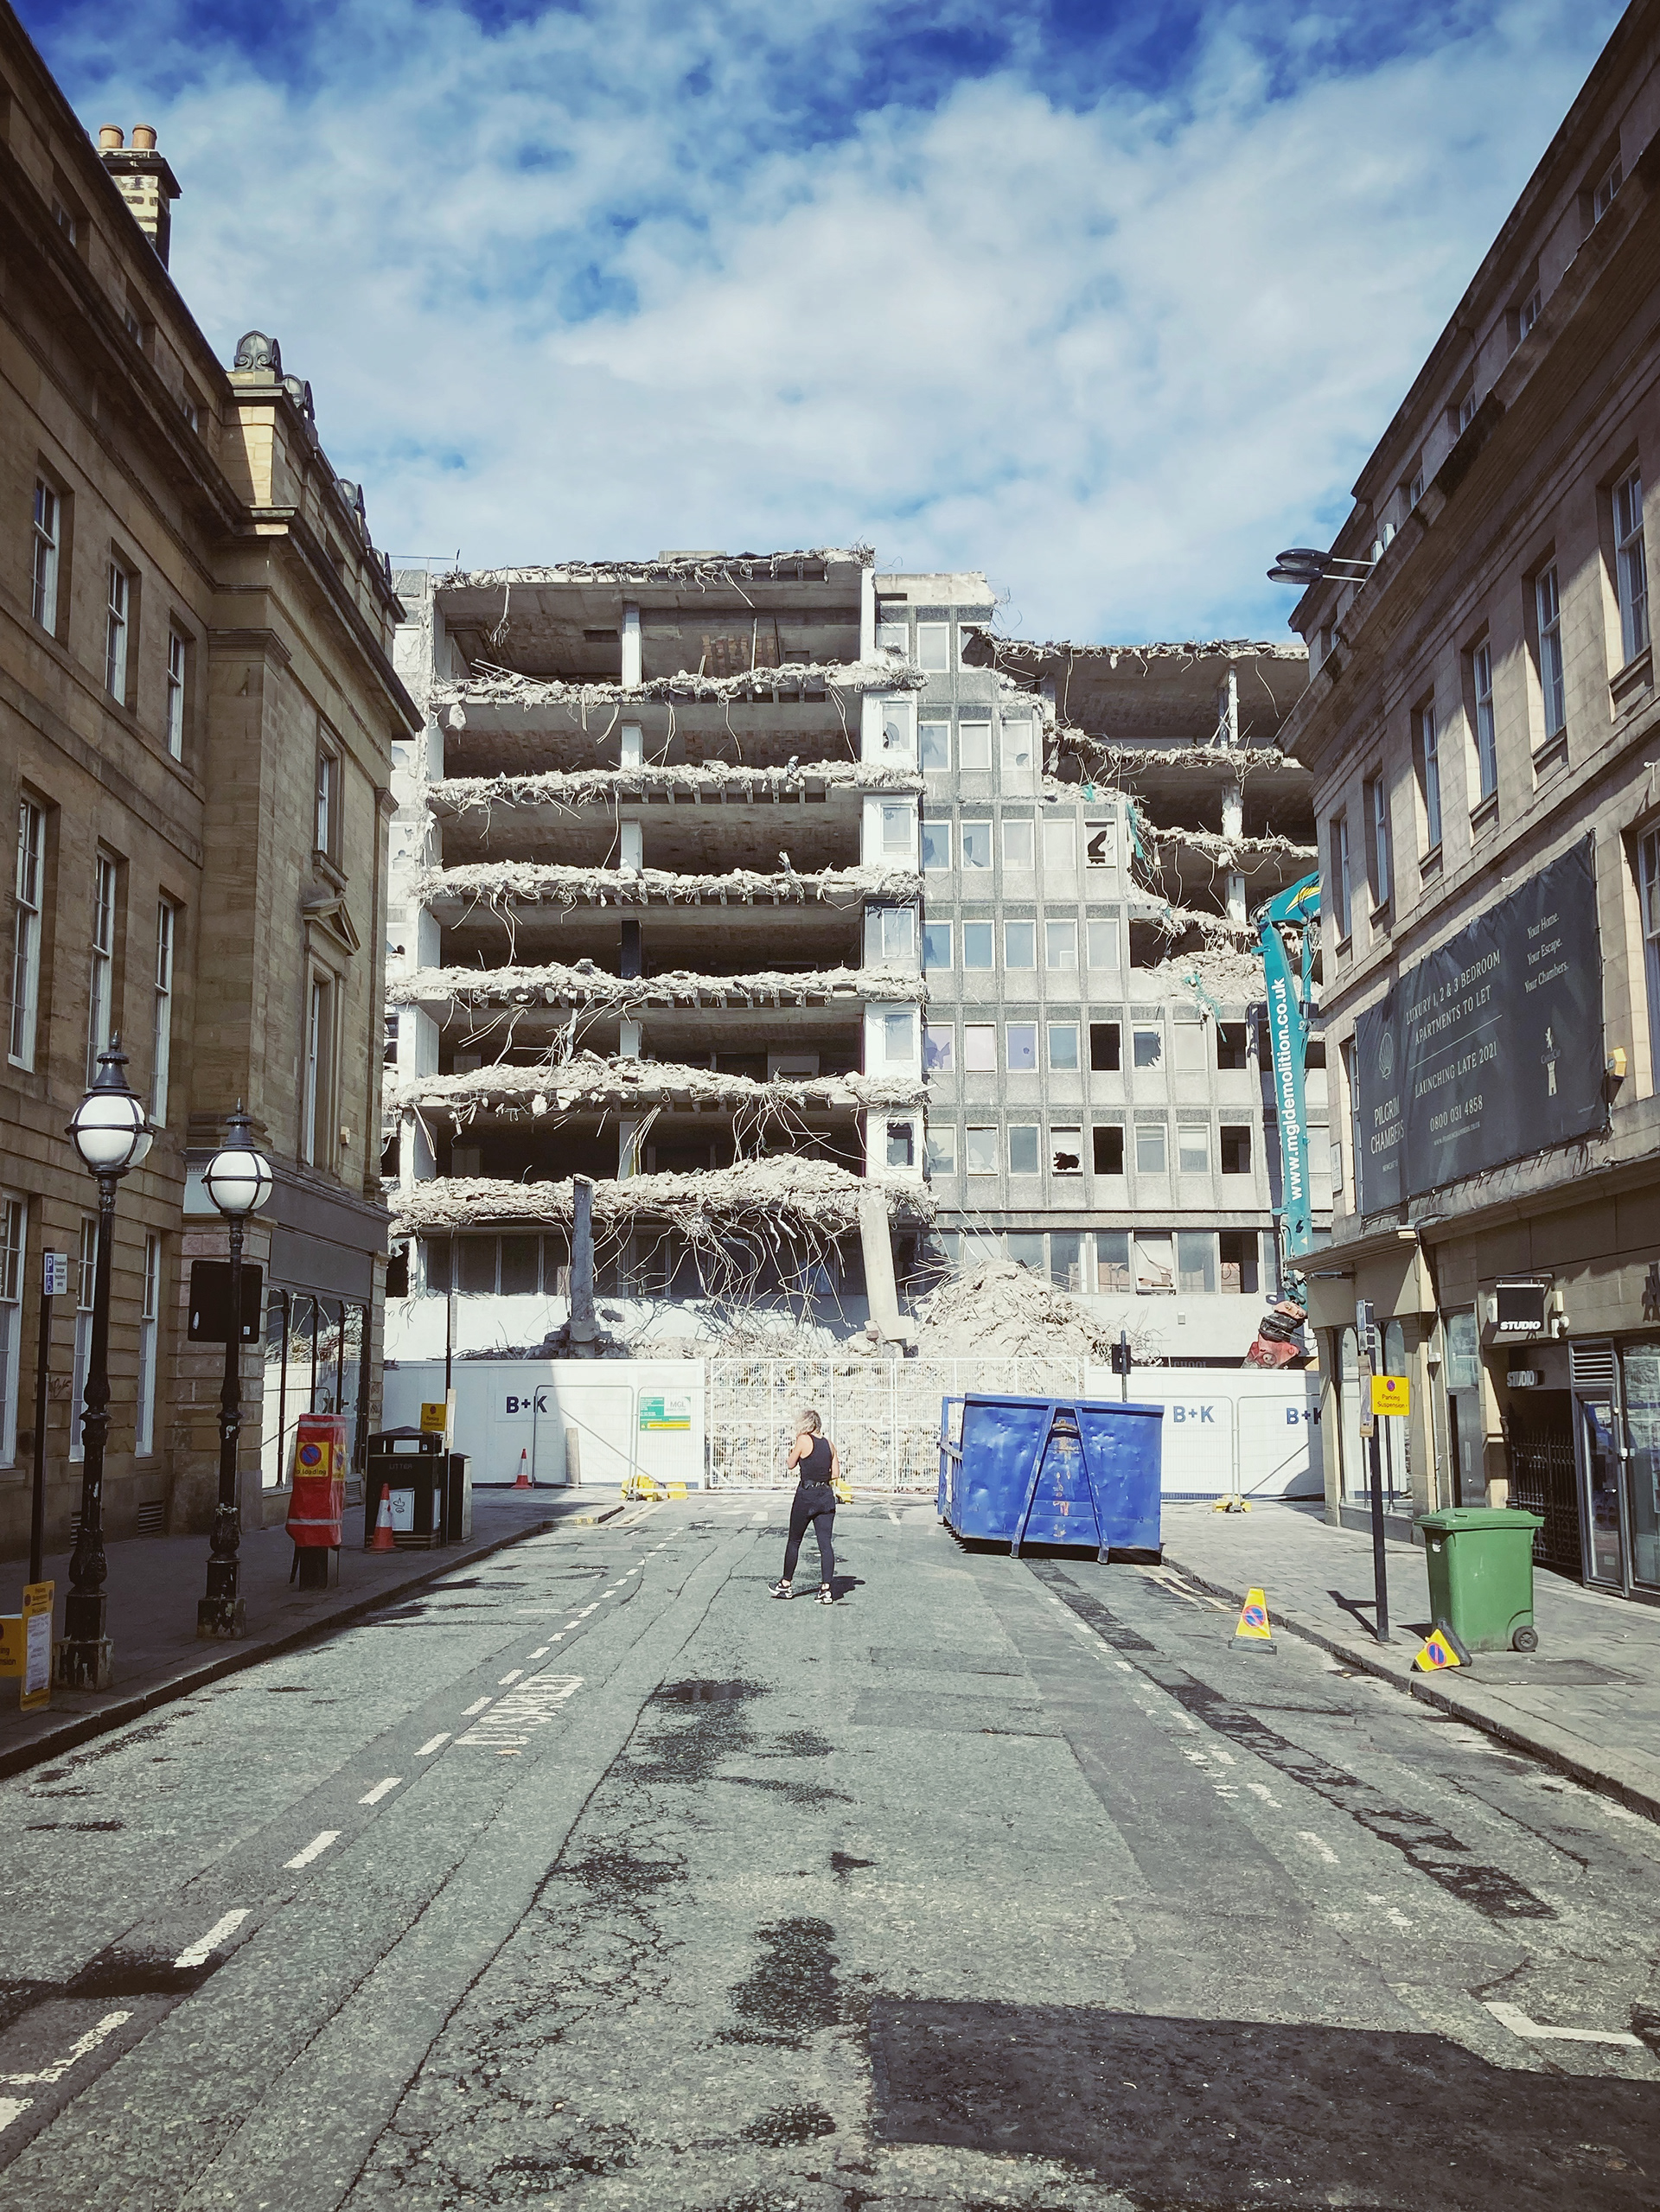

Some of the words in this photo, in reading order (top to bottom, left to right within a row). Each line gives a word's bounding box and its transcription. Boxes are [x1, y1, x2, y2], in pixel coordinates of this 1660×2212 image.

[1527, 924, 1540, 940] Your
[1541, 913, 1560, 931] Home.
[1527, 951, 1540, 966] Your
[1541, 938, 1562, 958] Escape.
[1406, 995, 1431, 1026] LUXURY
[1440, 987, 1445, 1002] 2
[1446, 983, 1452, 998] &
[1453, 978, 1459, 992] 3
[1460, 949, 1501, 988] BEDROOM
[1524, 979, 1537, 994] Your
[1538, 961, 1569, 985] Chambers.
[1414, 1004, 1461, 1046] APARTMENTS
[1463, 996, 1474, 1016] TO
[1476, 985, 1491, 1008] LET
[1414, 1064, 1455, 1099] LAUNCHING
[1457, 1052, 1478, 1075] LATE
[1479, 1041, 1497, 1064] 2021
[1272, 977, 1303, 1201] www.mgldemolition.co.uk
[1374, 1095, 1400, 1127] PILGRIM
[1429, 1111, 1448, 1132] 0800
[1450, 1105, 1462, 1122] 031
[1464, 1094, 1483, 1116] 4858
[1370, 1119, 1405, 1155] CHAMBERS
[48, 1258, 53, 1272] P
[1500, 1321, 1542, 1330] STUDIO
[1506, 1370, 1536, 1387] STUDIO
[506, 1395, 548, 1414] B+K
[1382, 1393, 1400, 1402] Parking
[1172, 1406, 1215, 1424] B+K
[302, 1468, 327, 1476] loading
